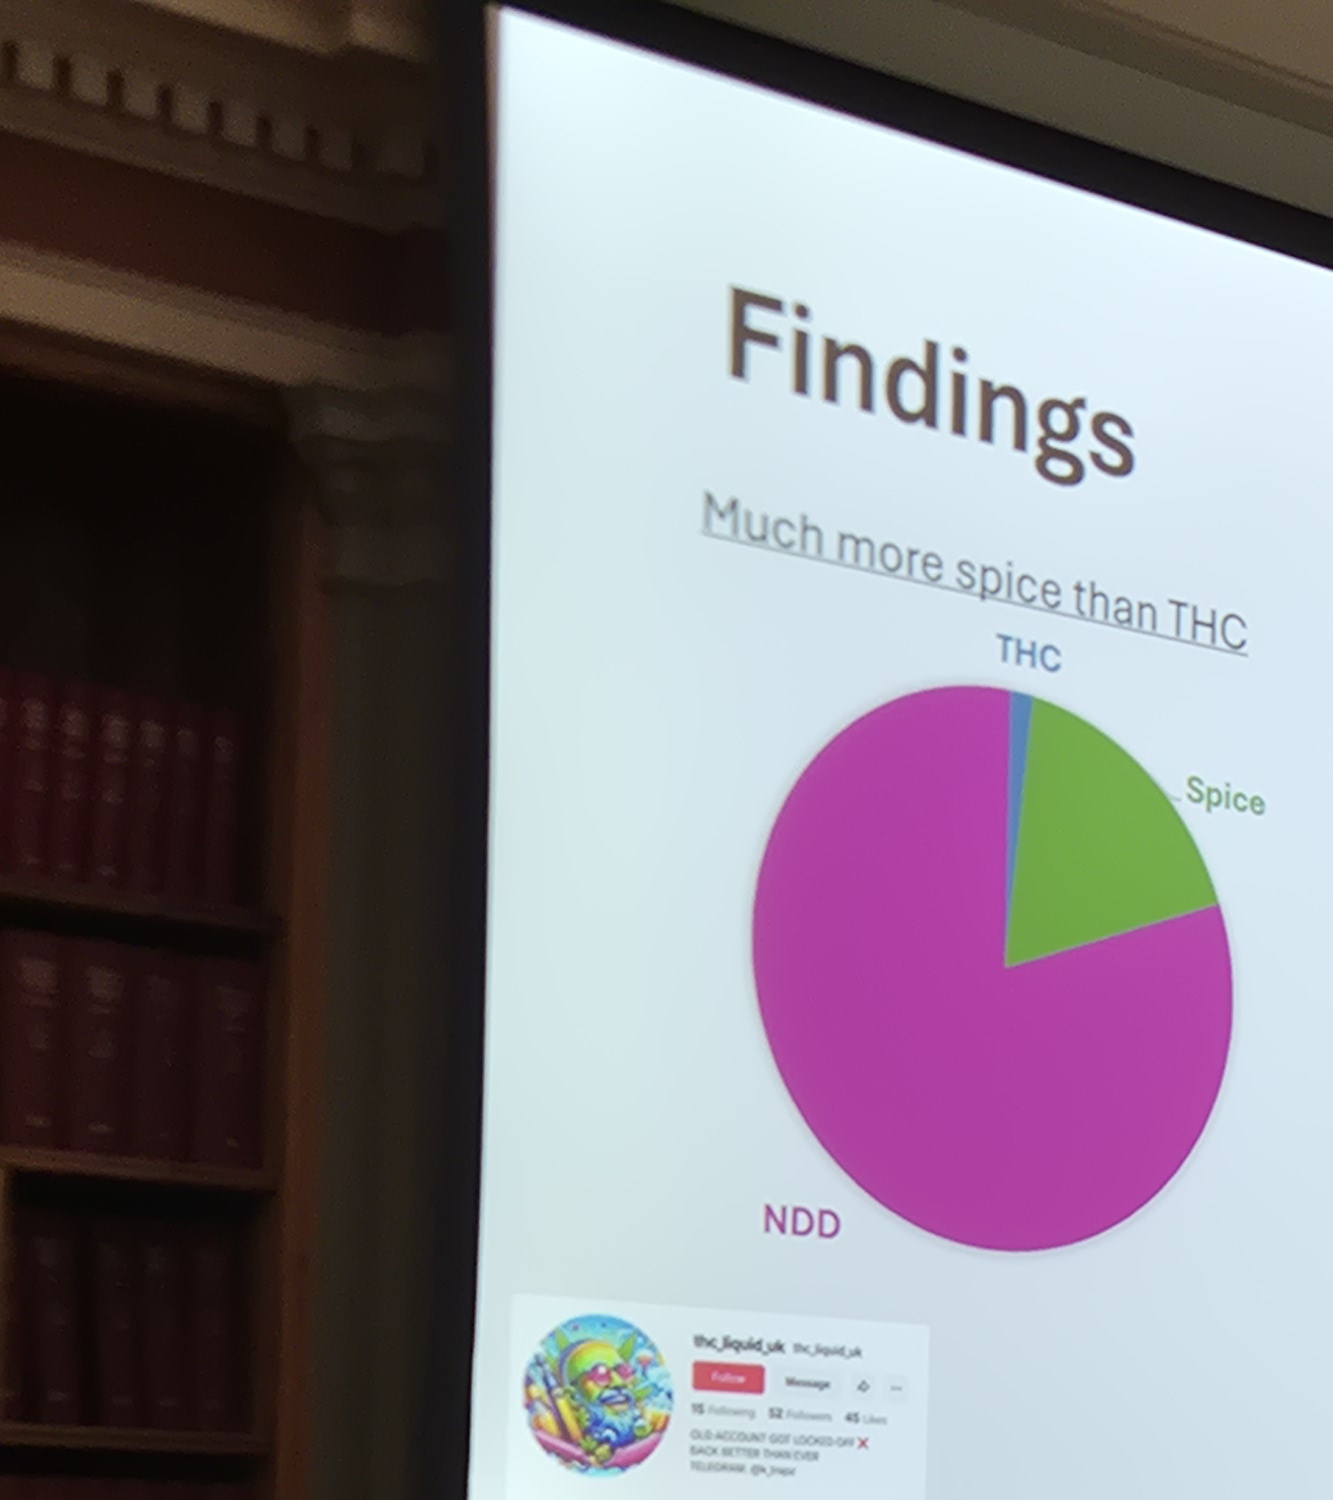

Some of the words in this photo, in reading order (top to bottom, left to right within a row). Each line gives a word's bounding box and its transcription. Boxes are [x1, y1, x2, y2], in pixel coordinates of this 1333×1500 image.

[728, 284, 1137, 487] Findings
[702, 489, 823, 558] Much
[836, 527, 944, 583] more
[956, 550, 1063, 608] spice
[1073, 578, 1158, 632] than
[1168, 598, 1249, 651] THC
[996, 633, 1063, 674] THC
[1185, 775, 1267, 815] Spice
[764, 1203, 841, 1240] NDD
